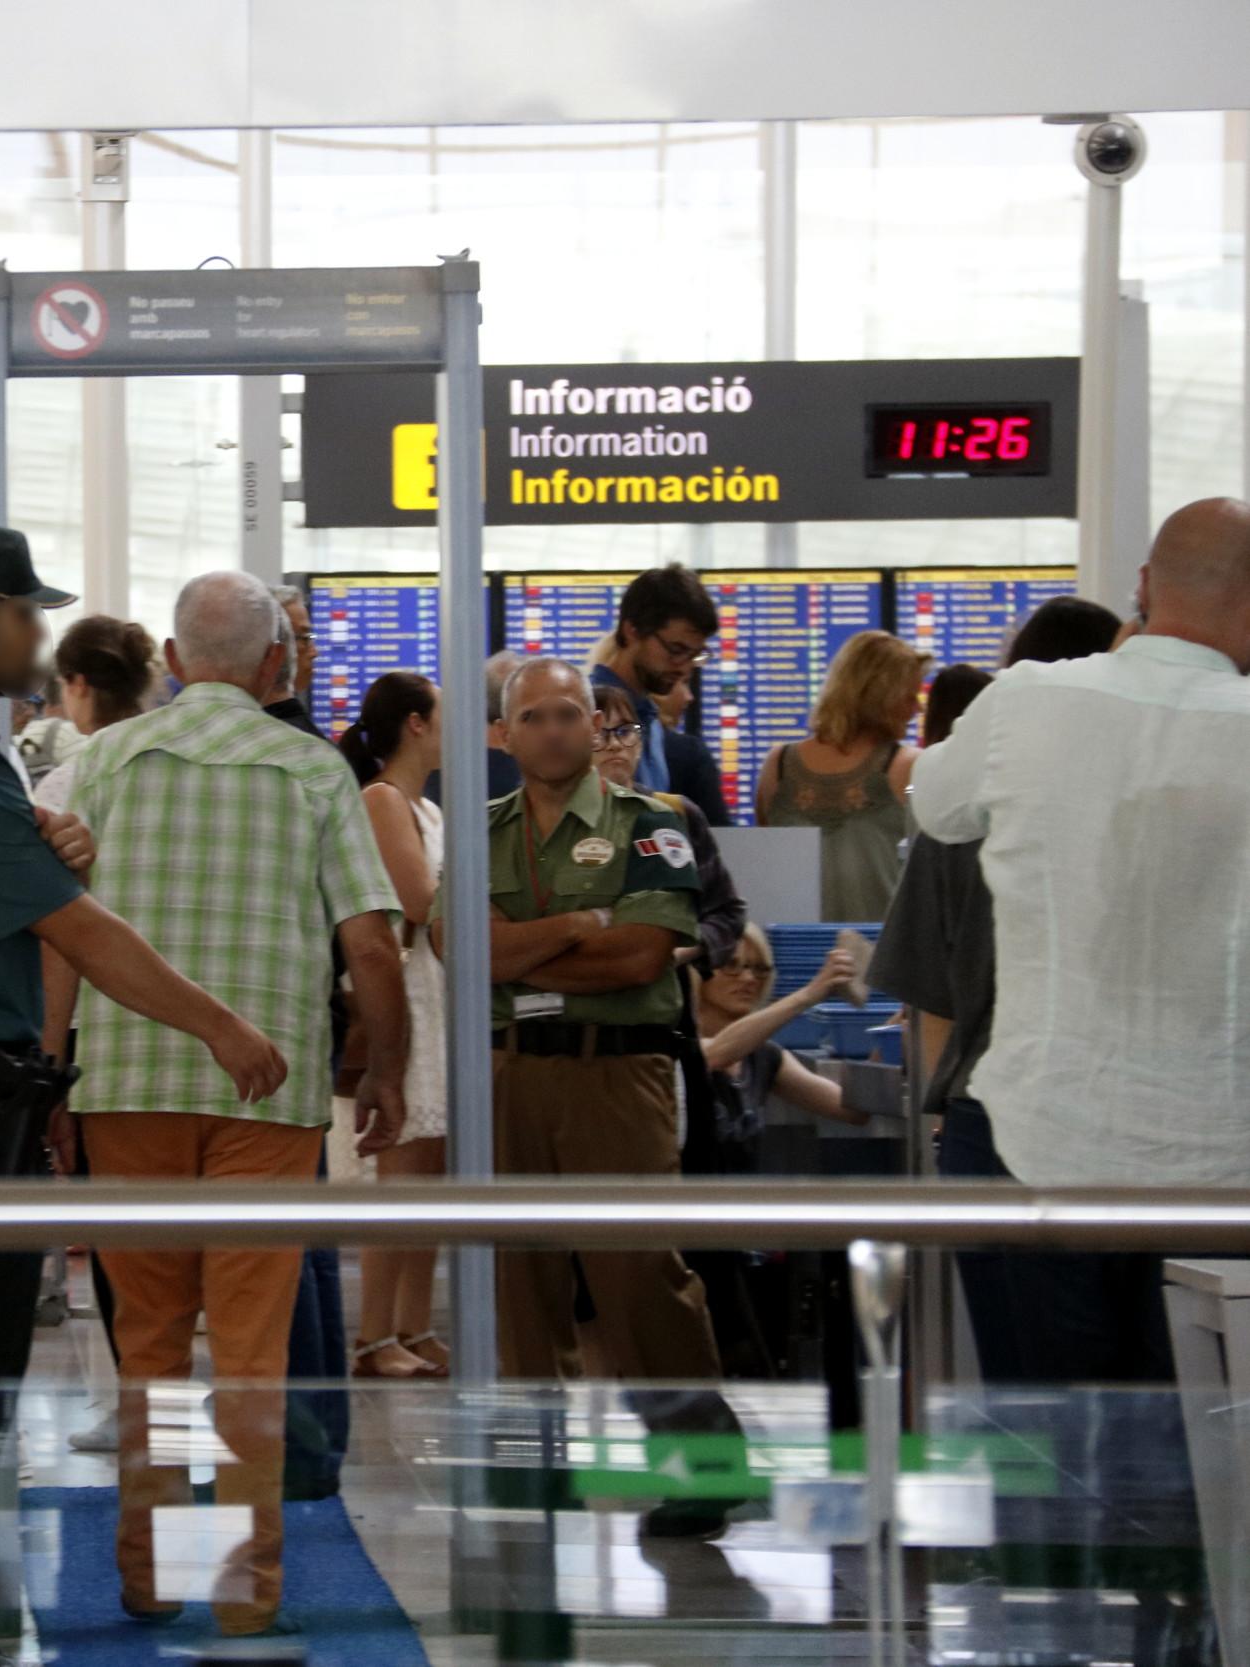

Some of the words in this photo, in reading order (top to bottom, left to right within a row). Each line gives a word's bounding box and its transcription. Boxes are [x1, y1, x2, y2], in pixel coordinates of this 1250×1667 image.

[510, 376, 752, 415] Informació
[510, 425, 708, 457] Information
[899, 417, 1031, 460] 11:26
[511, 465, 779, 504] Información
